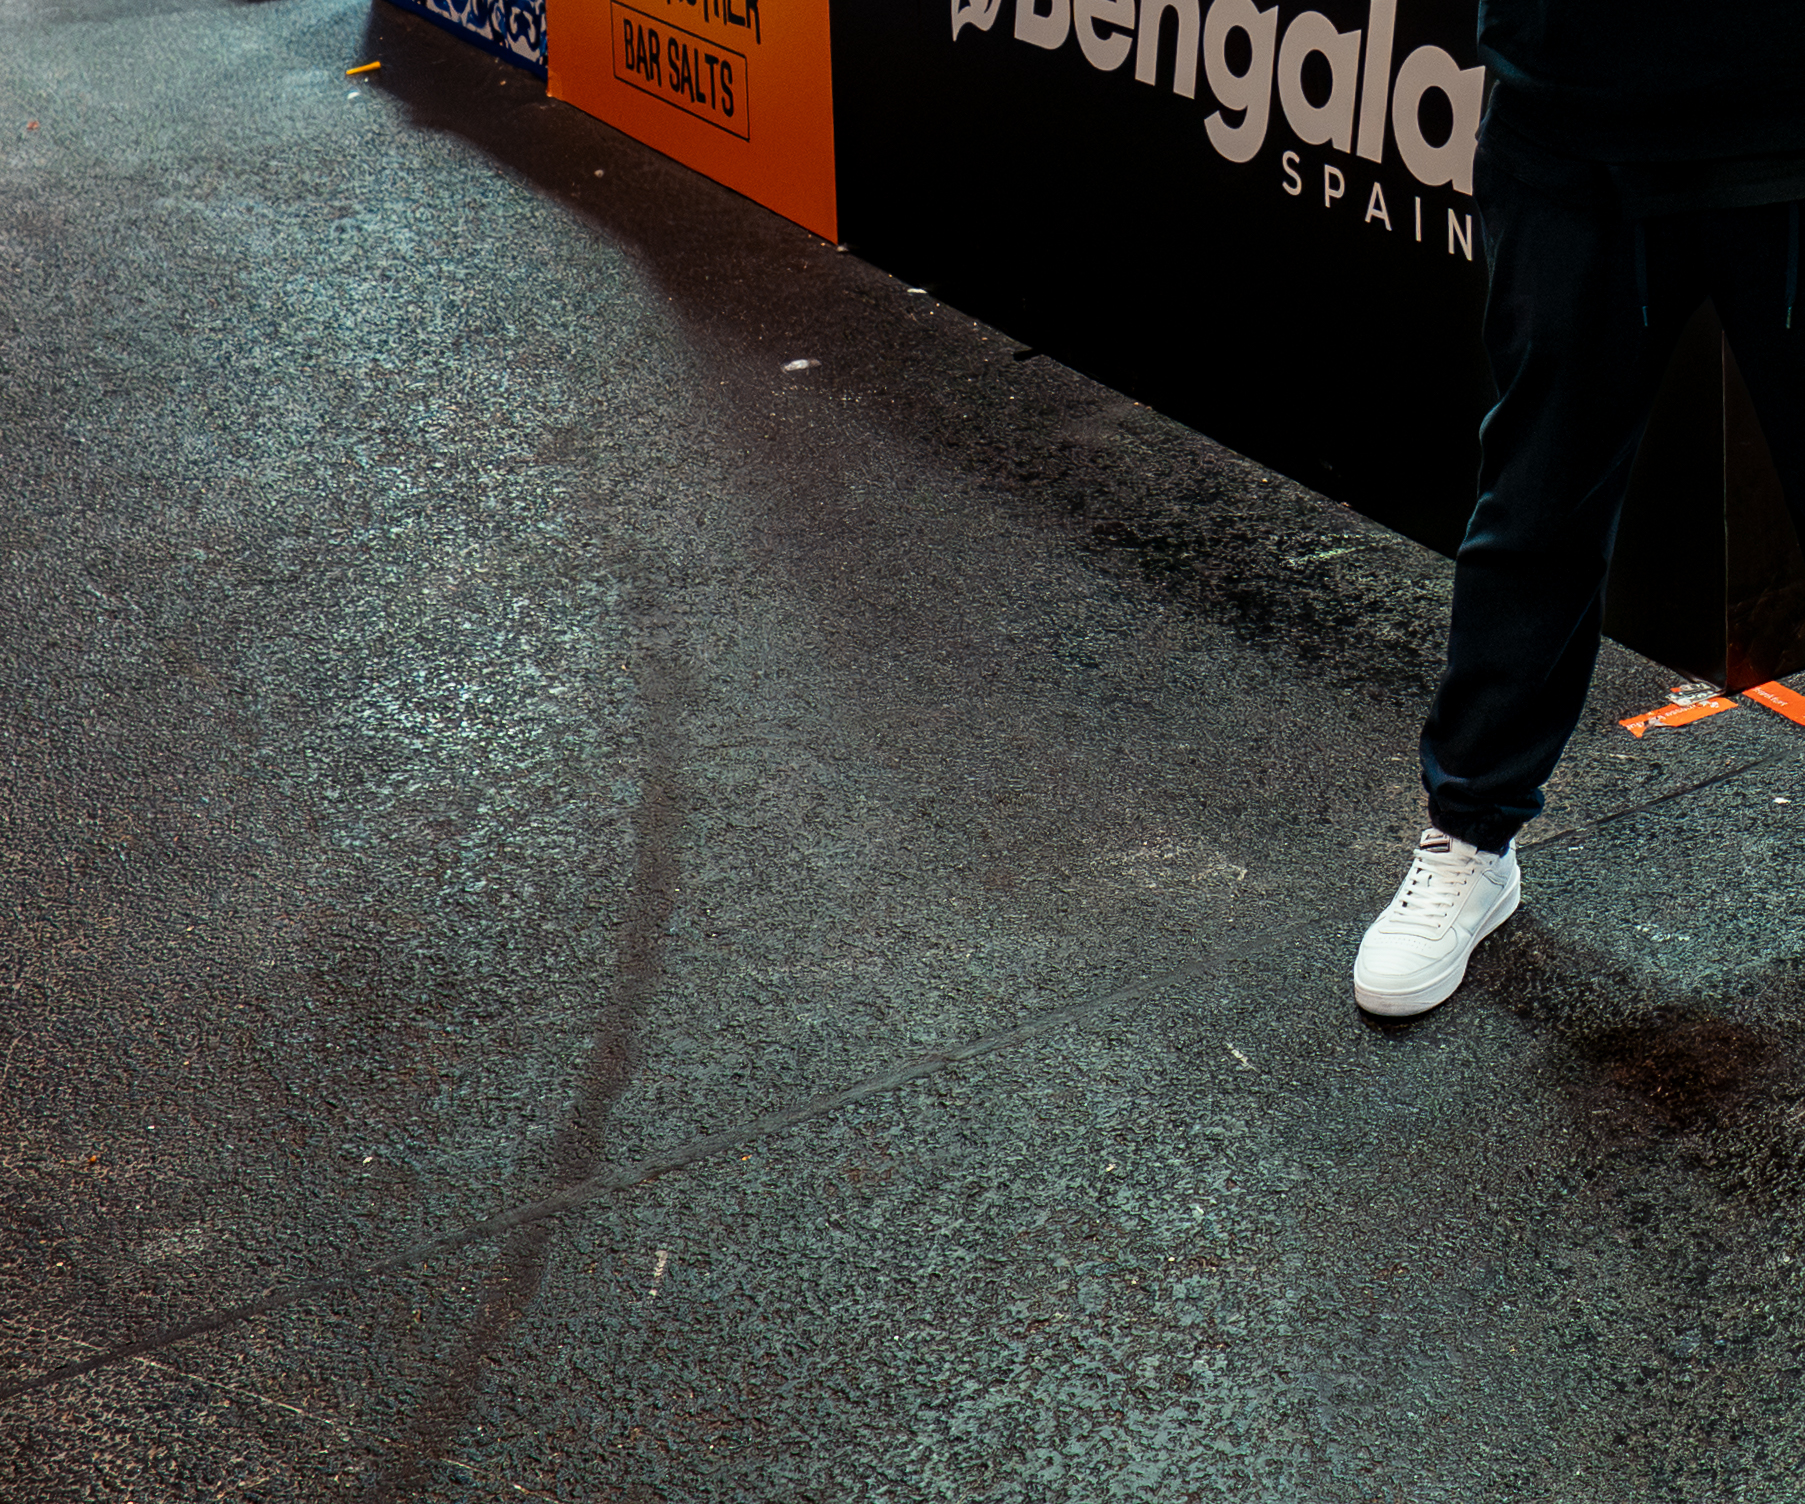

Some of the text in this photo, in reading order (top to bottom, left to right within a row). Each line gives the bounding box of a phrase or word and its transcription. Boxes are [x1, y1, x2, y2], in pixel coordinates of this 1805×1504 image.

[624, 18, 735, 119] BAR SALTS
[1281, 150, 1473, 261] SPAIN
